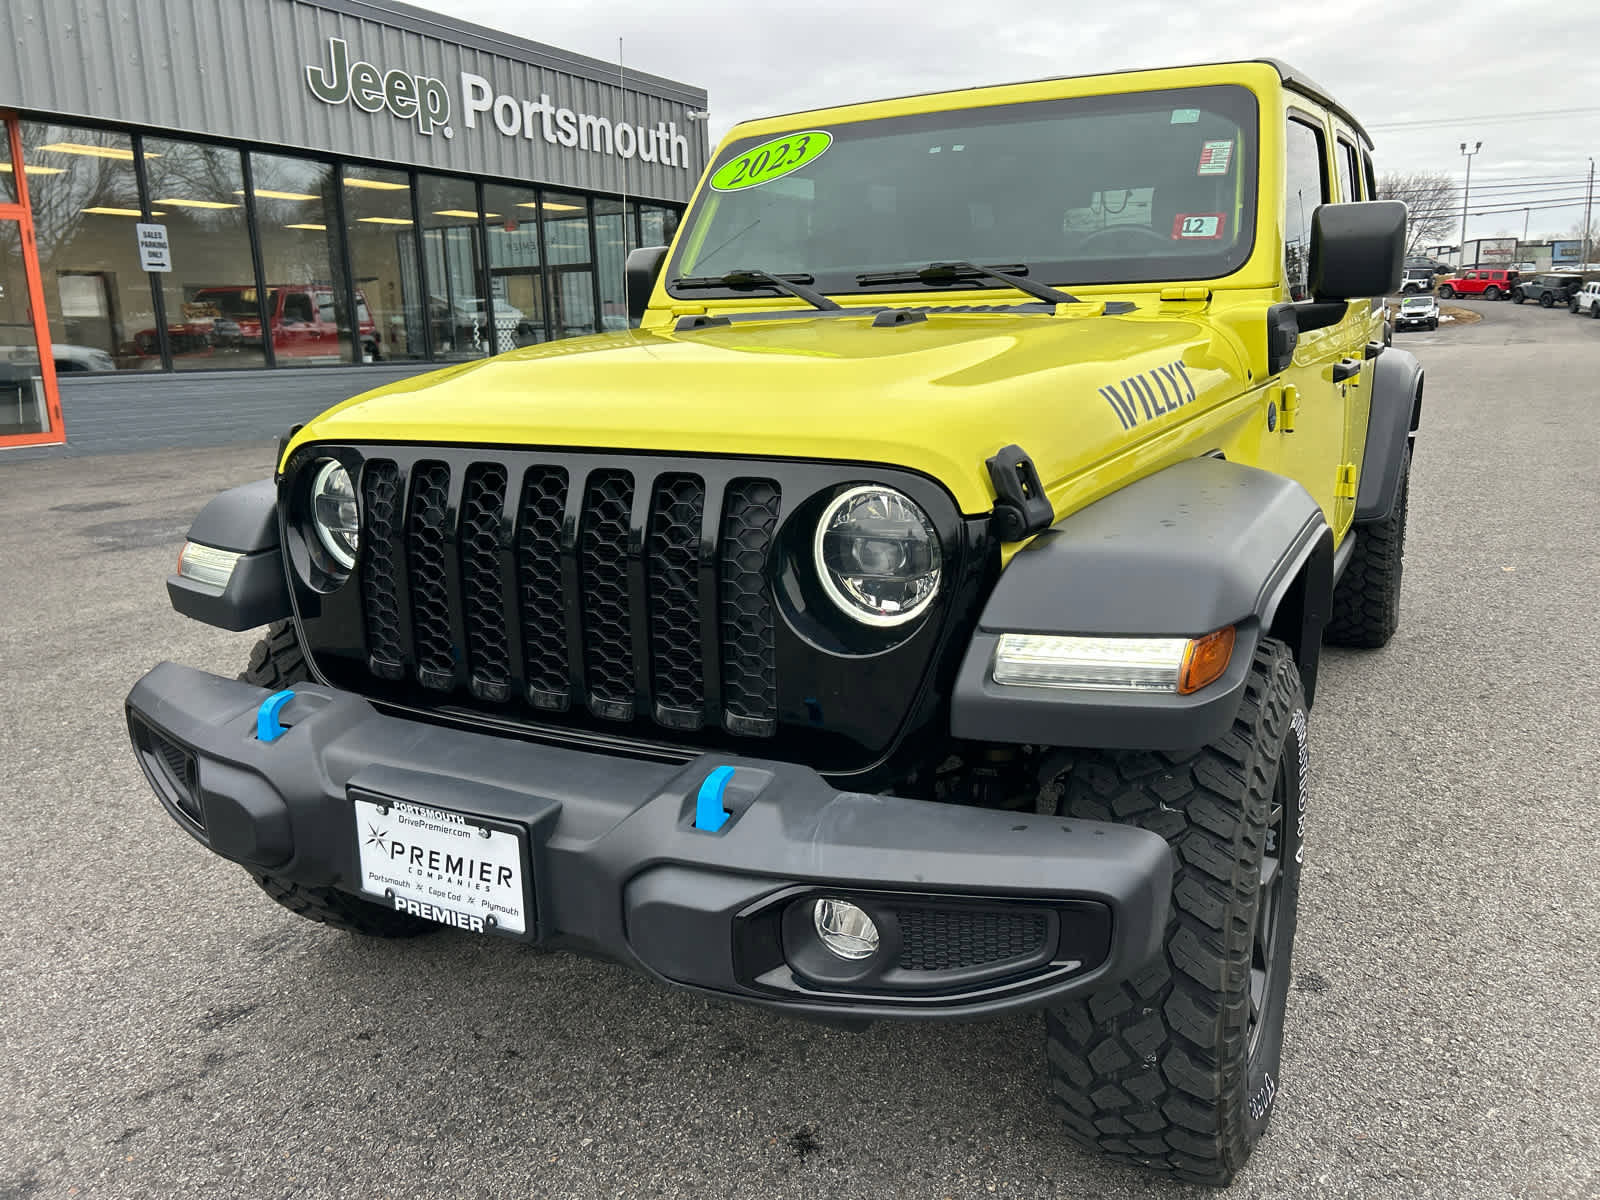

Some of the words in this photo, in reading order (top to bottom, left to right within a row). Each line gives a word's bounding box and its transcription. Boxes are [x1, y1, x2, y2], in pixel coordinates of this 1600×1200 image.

[306, 37, 451, 135] Jeep
[460, 71, 688, 169] Portsmouth
[727, 136, 810, 186] 2023
[1182, 218, 1205, 233] 12
[1098, 360, 1195, 430] WILLYS
[393, 801, 466, 825] PORTSMOUTH
[398, 815, 471, 838] DrivePremier.com
[391, 841, 513, 888] PREMIER
[408, 866, 491, 893] COMPANIES
[368, 871, 411, 889] Portsmouth
[428, 886, 446, 899] Cape
[447, 889, 462, 902] Cod
[481, 899, 520, 917] Plymouth
[394, 897, 484, 933] PREMIER
